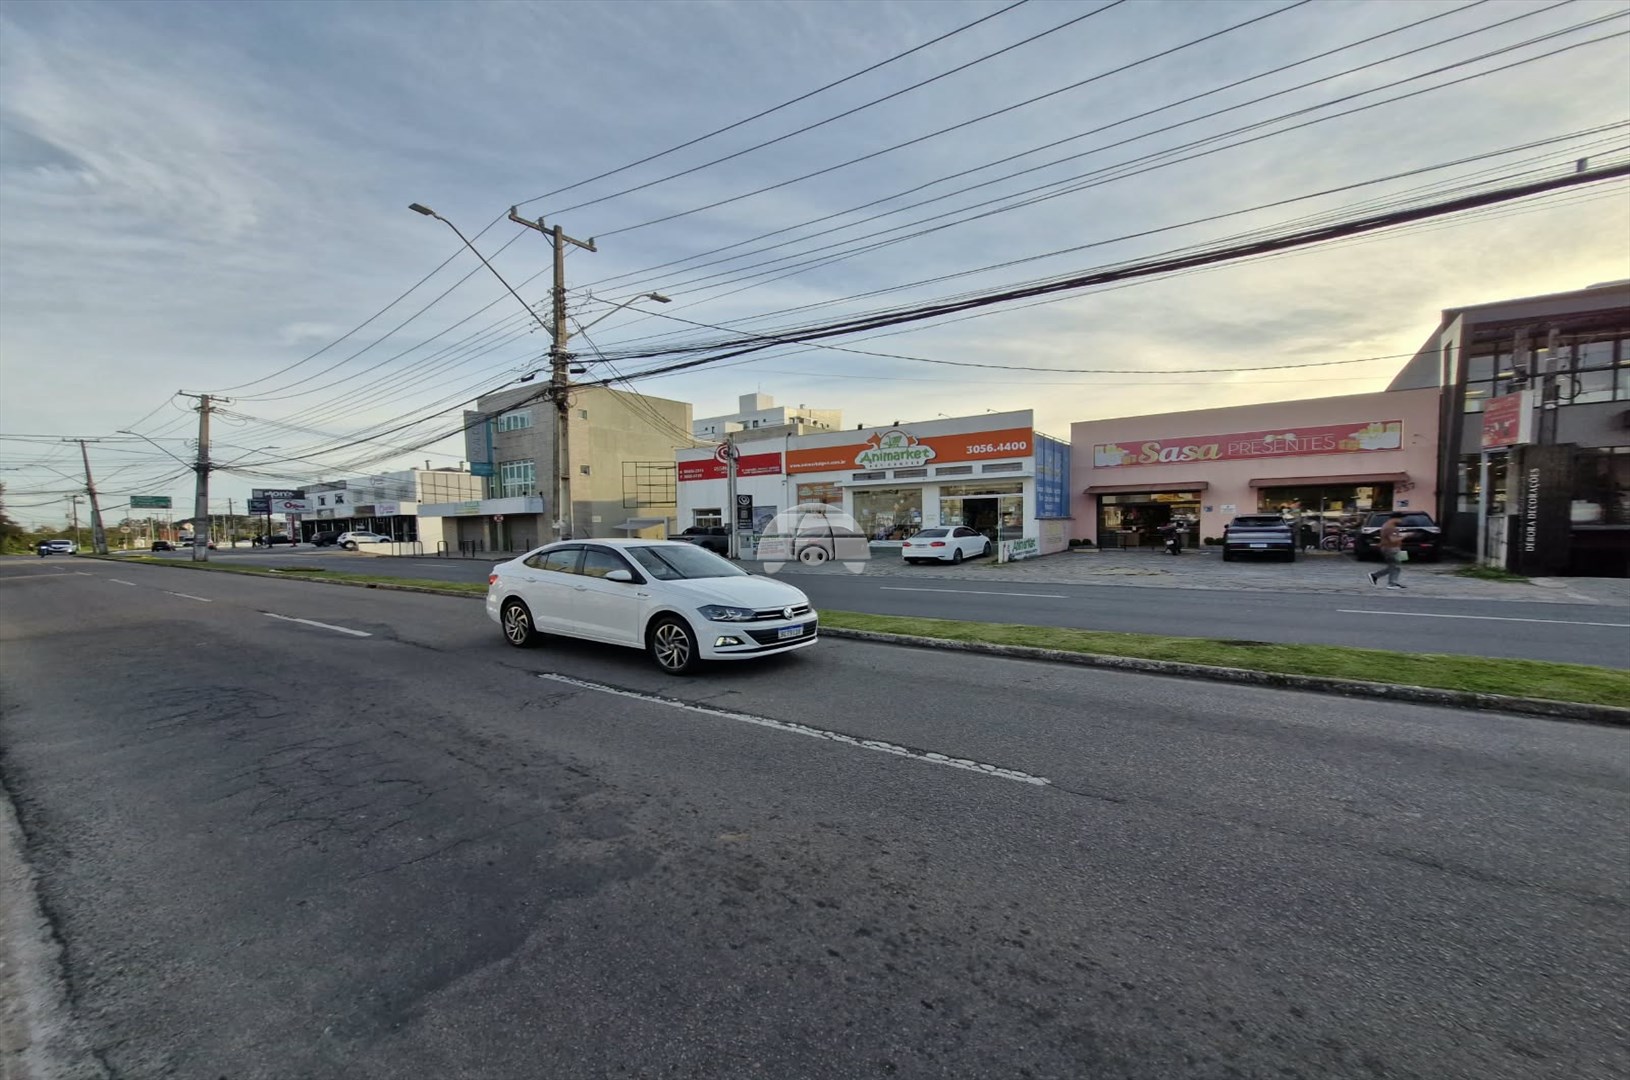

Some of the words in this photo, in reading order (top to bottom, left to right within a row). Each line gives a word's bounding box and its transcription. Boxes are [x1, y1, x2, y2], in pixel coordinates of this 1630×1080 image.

[966, 441, 1027, 454] 3056.4400
[1138, 441, 1223, 464] Sasa
[1227, 434, 1336, 456] PRESENTES
[860, 448, 930, 464] Animarket
